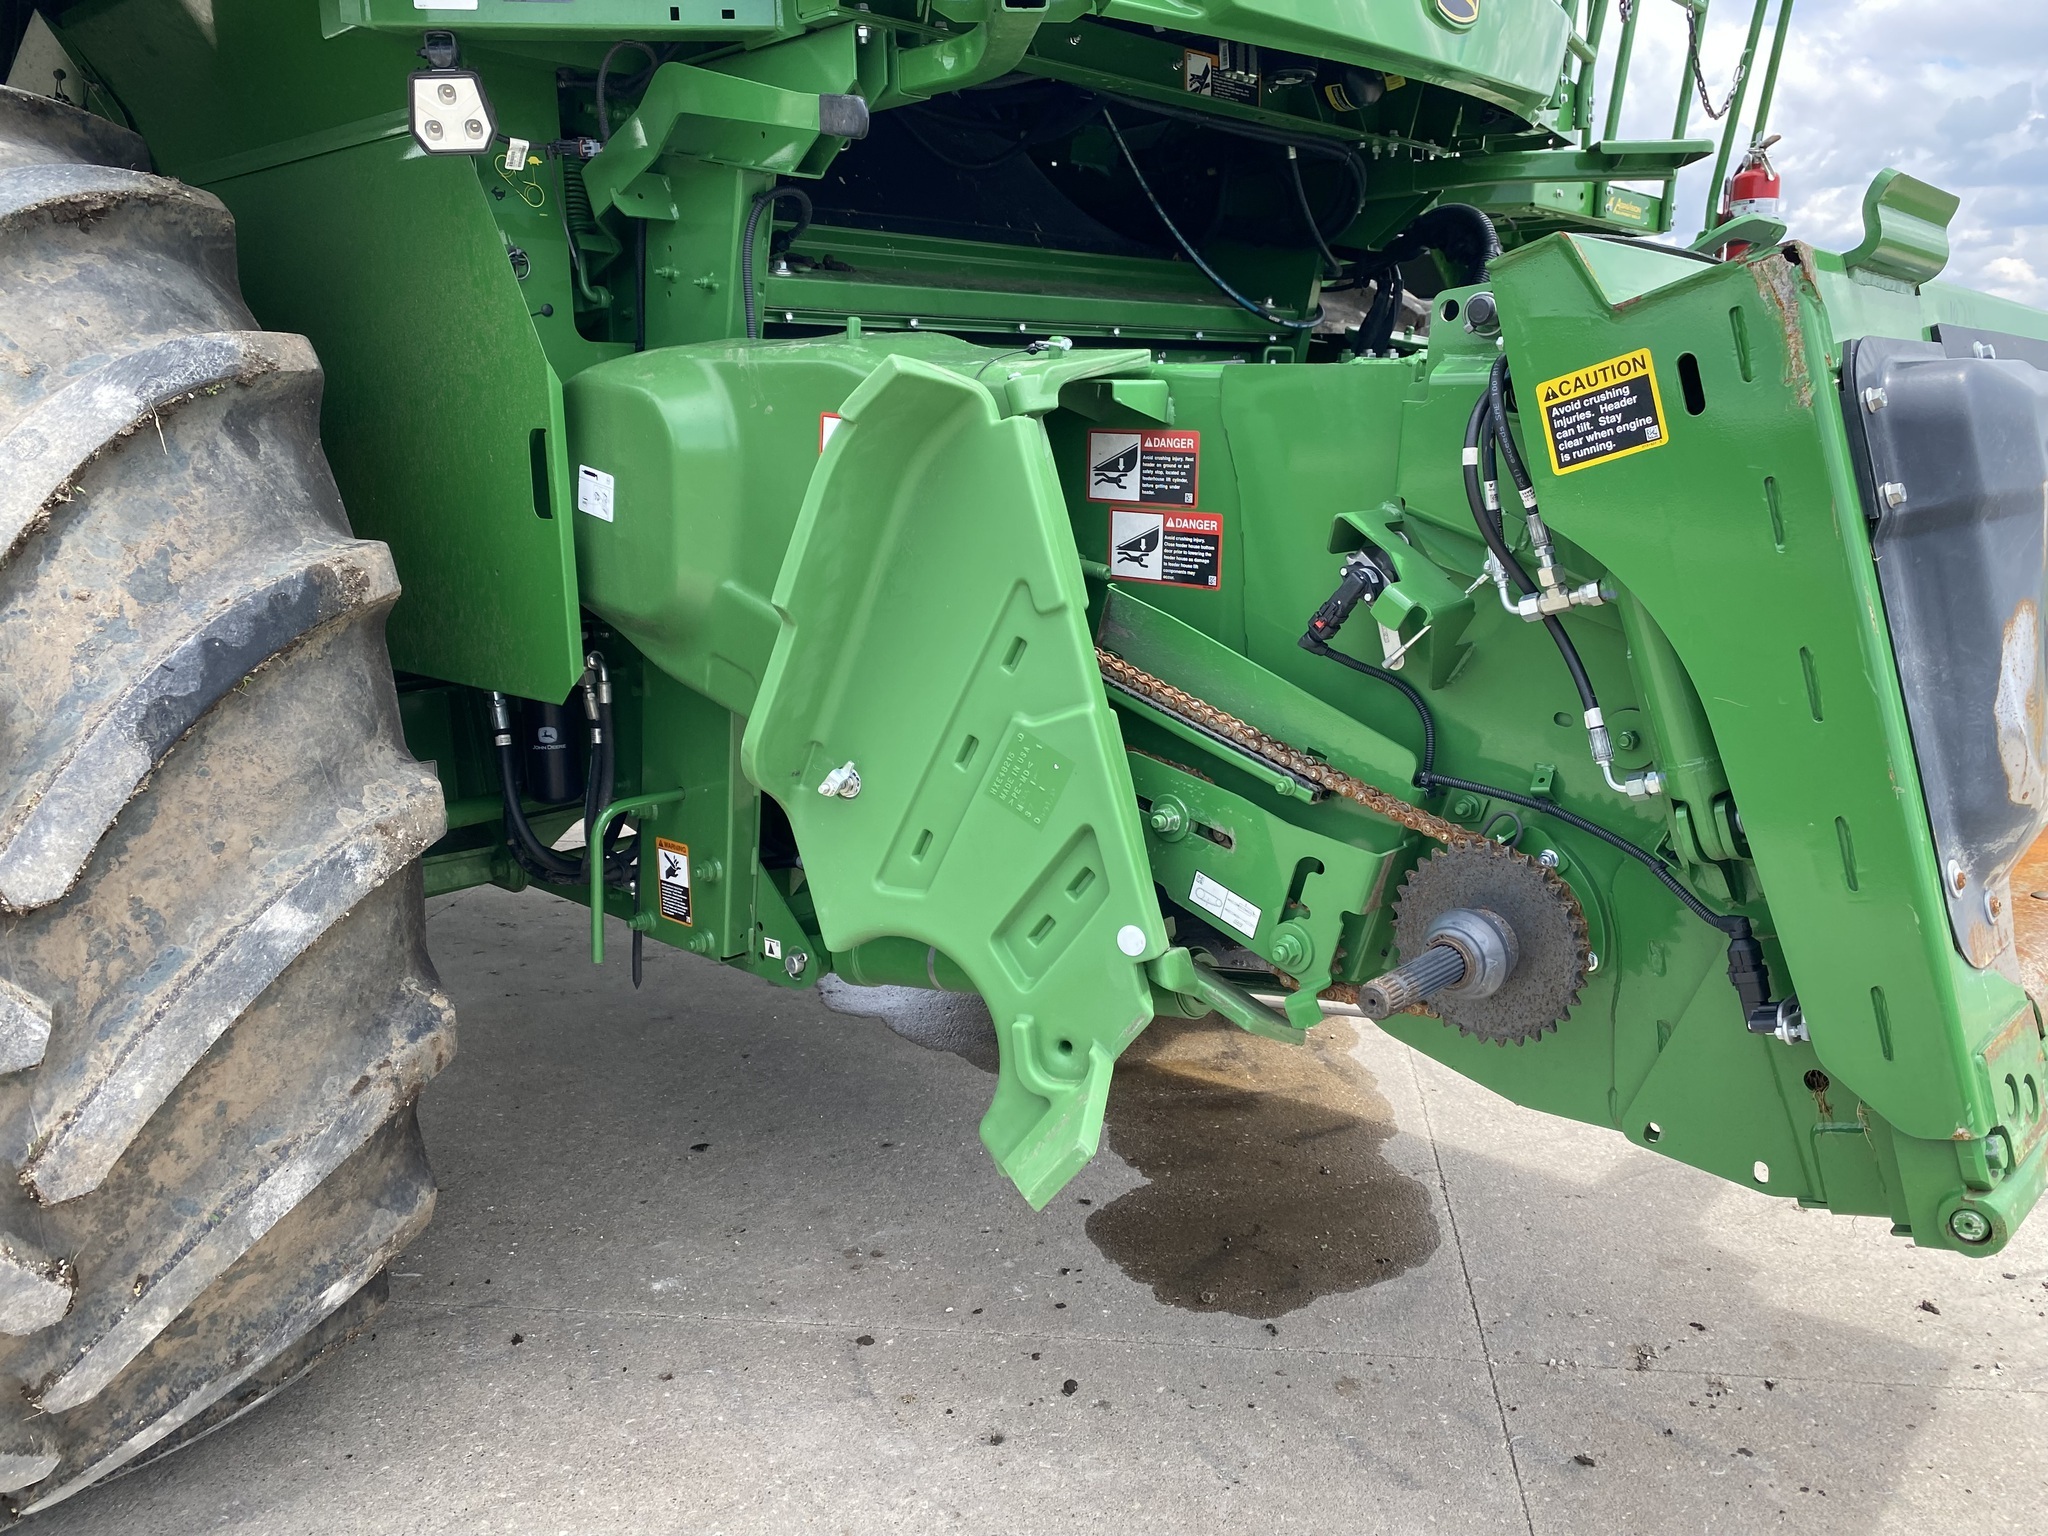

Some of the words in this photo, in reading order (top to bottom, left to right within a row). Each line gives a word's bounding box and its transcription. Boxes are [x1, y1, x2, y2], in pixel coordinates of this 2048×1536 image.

[1558, 354, 1646, 396] CAUTION
[1493, 403, 1502, 421] SAE
[1552, 401, 1581, 417] Avoid
[1583, 385, 1631, 408] crushing
[1553, 412, 1595, 429] injuries.
[1599, 395, 1638, 414] Header
[1556, 427, 1575, 440] can
[1576, 420, 1594, 434] tilt.
[1598, 412, 1623, 427] Stay
[1558, 437, 1583, 451] clear
[1586, 427, 1614, 443] when
[1617, 415, 1653, 435] engine
[1154, 438, 1194, 449] DANGER
[1500, 426, 1515, 464] exceeds
[1561, 451, 1571, 462] is
[1573, 440, 1616, 458] running.
[1176, 518, 1217, 531] DANGER
[999, 777, 1015, 801] MADE
[1012, 765, 1021, 777] IN
[1018, 746, 1030, 764] USA
